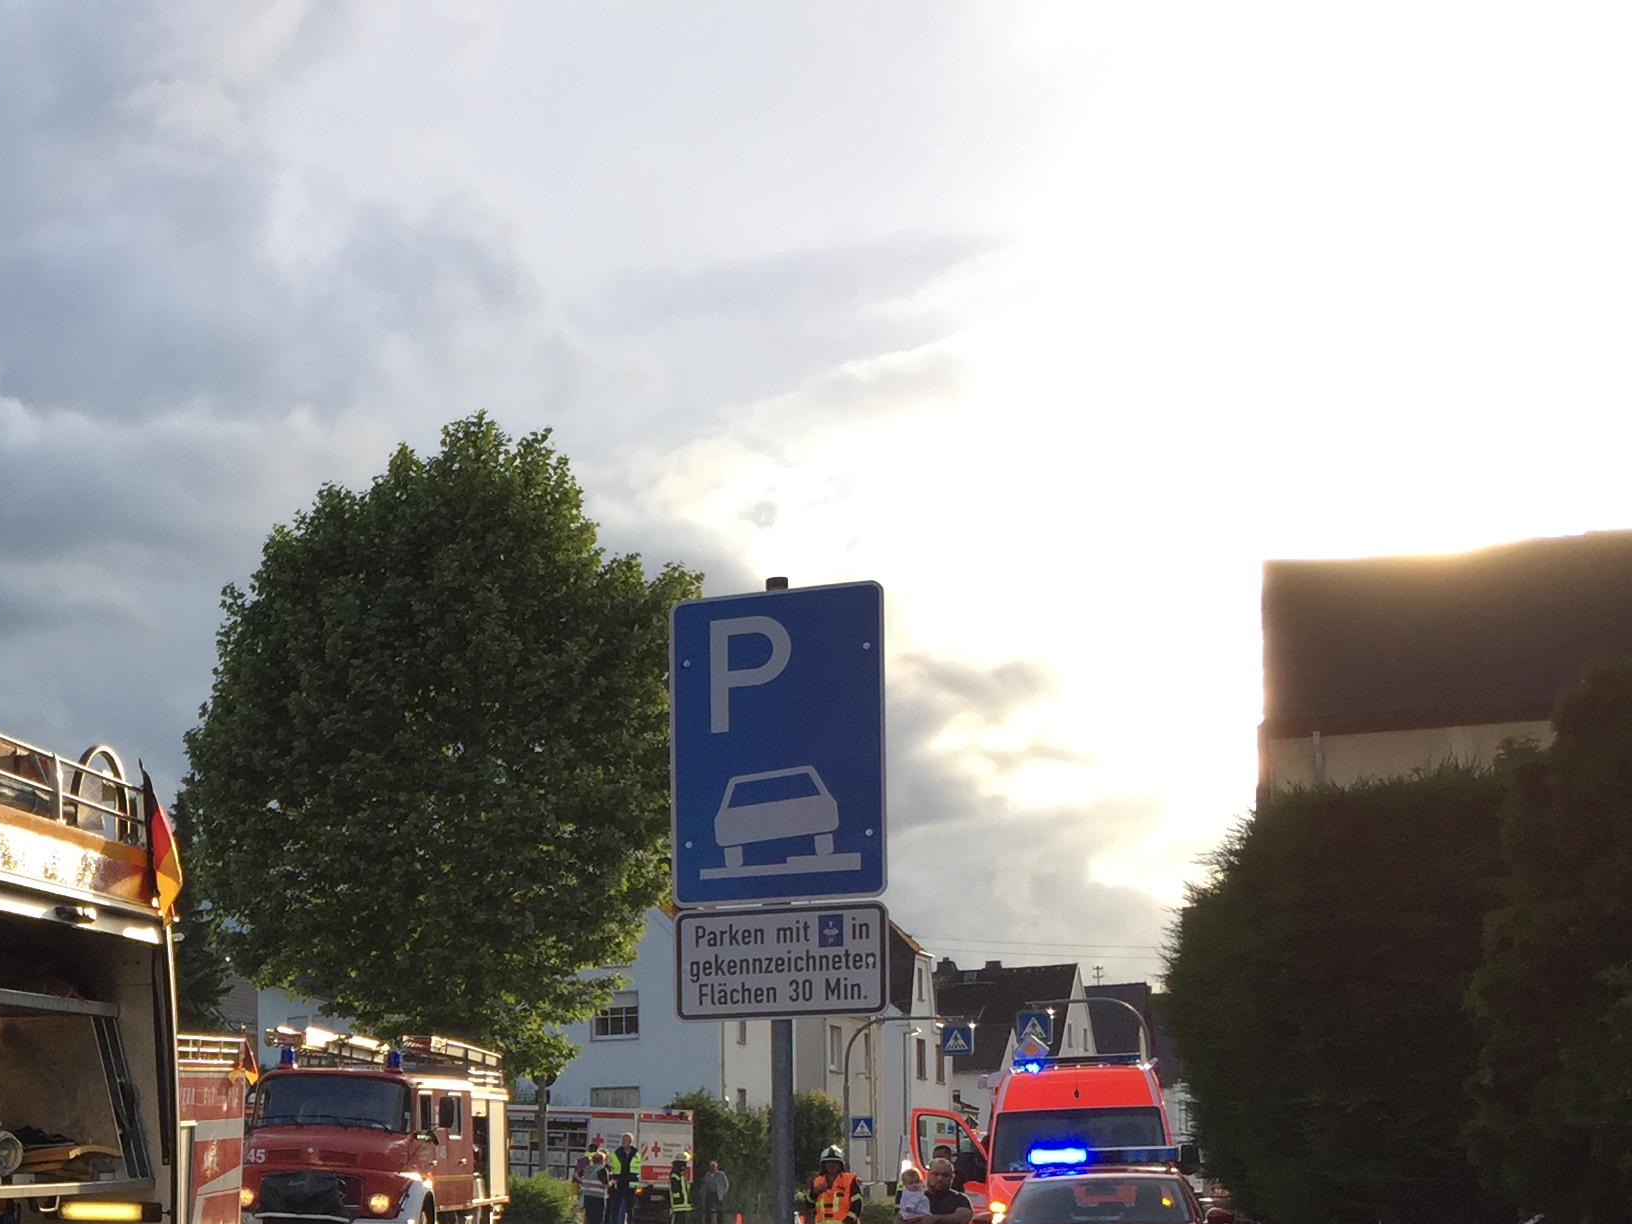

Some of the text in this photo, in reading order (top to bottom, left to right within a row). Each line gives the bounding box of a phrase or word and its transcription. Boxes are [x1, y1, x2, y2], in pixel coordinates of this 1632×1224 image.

[709, 615, 792, 733] P
[695, 917, 870, 948] Parken mit in
[689, 949, 877, 983] gekennzeichneten
[698, 977, 868, 1006] Flächen 30 Min.
